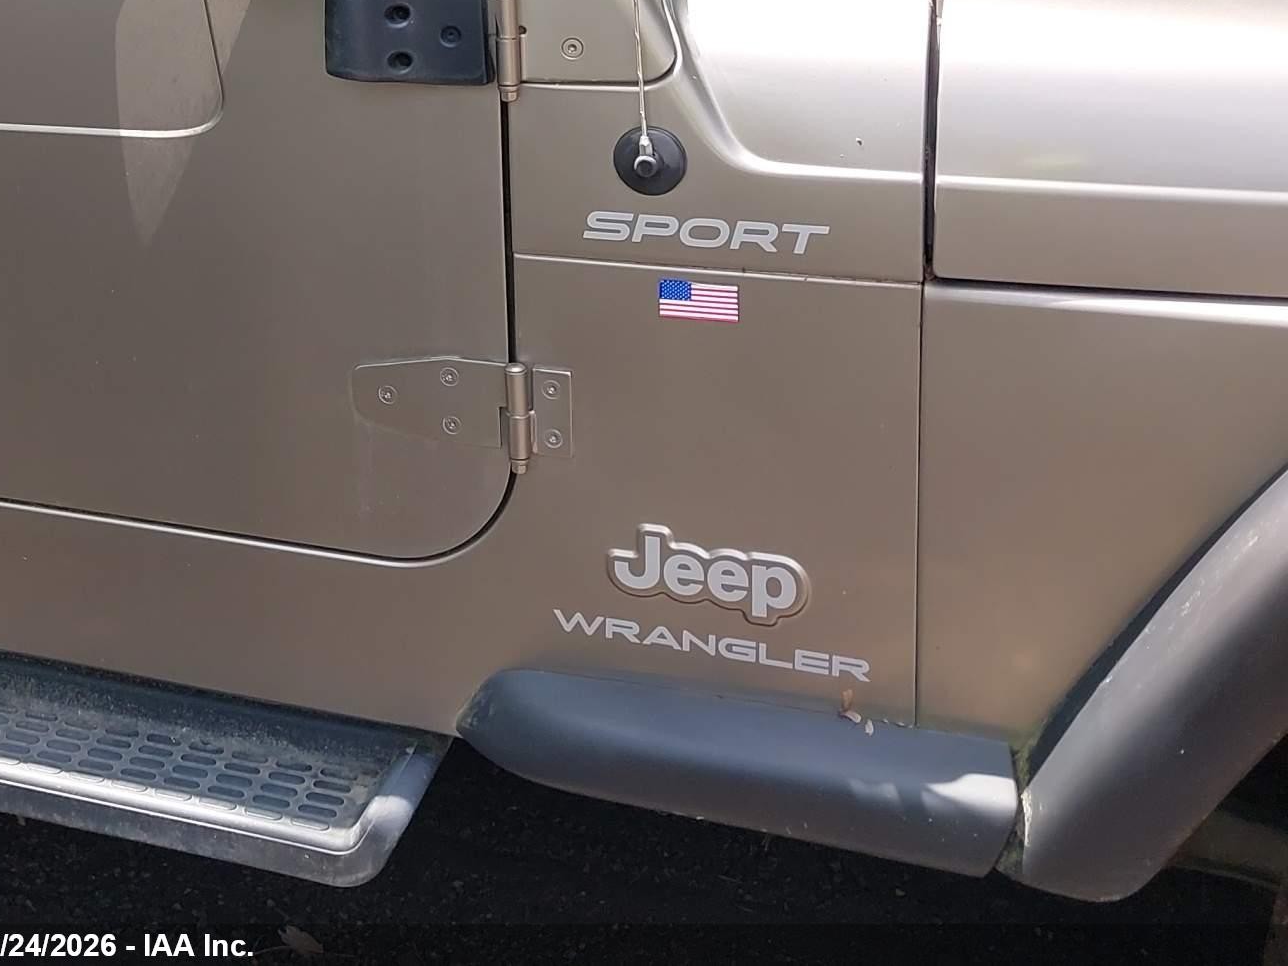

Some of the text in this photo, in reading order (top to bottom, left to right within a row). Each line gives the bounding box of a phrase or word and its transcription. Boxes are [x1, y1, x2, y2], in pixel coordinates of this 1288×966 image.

[583, 210, 831, 255] SPORT
[614, 535, 797, 618] Jeep
[553, 609, 871, 682] WRANGLER
